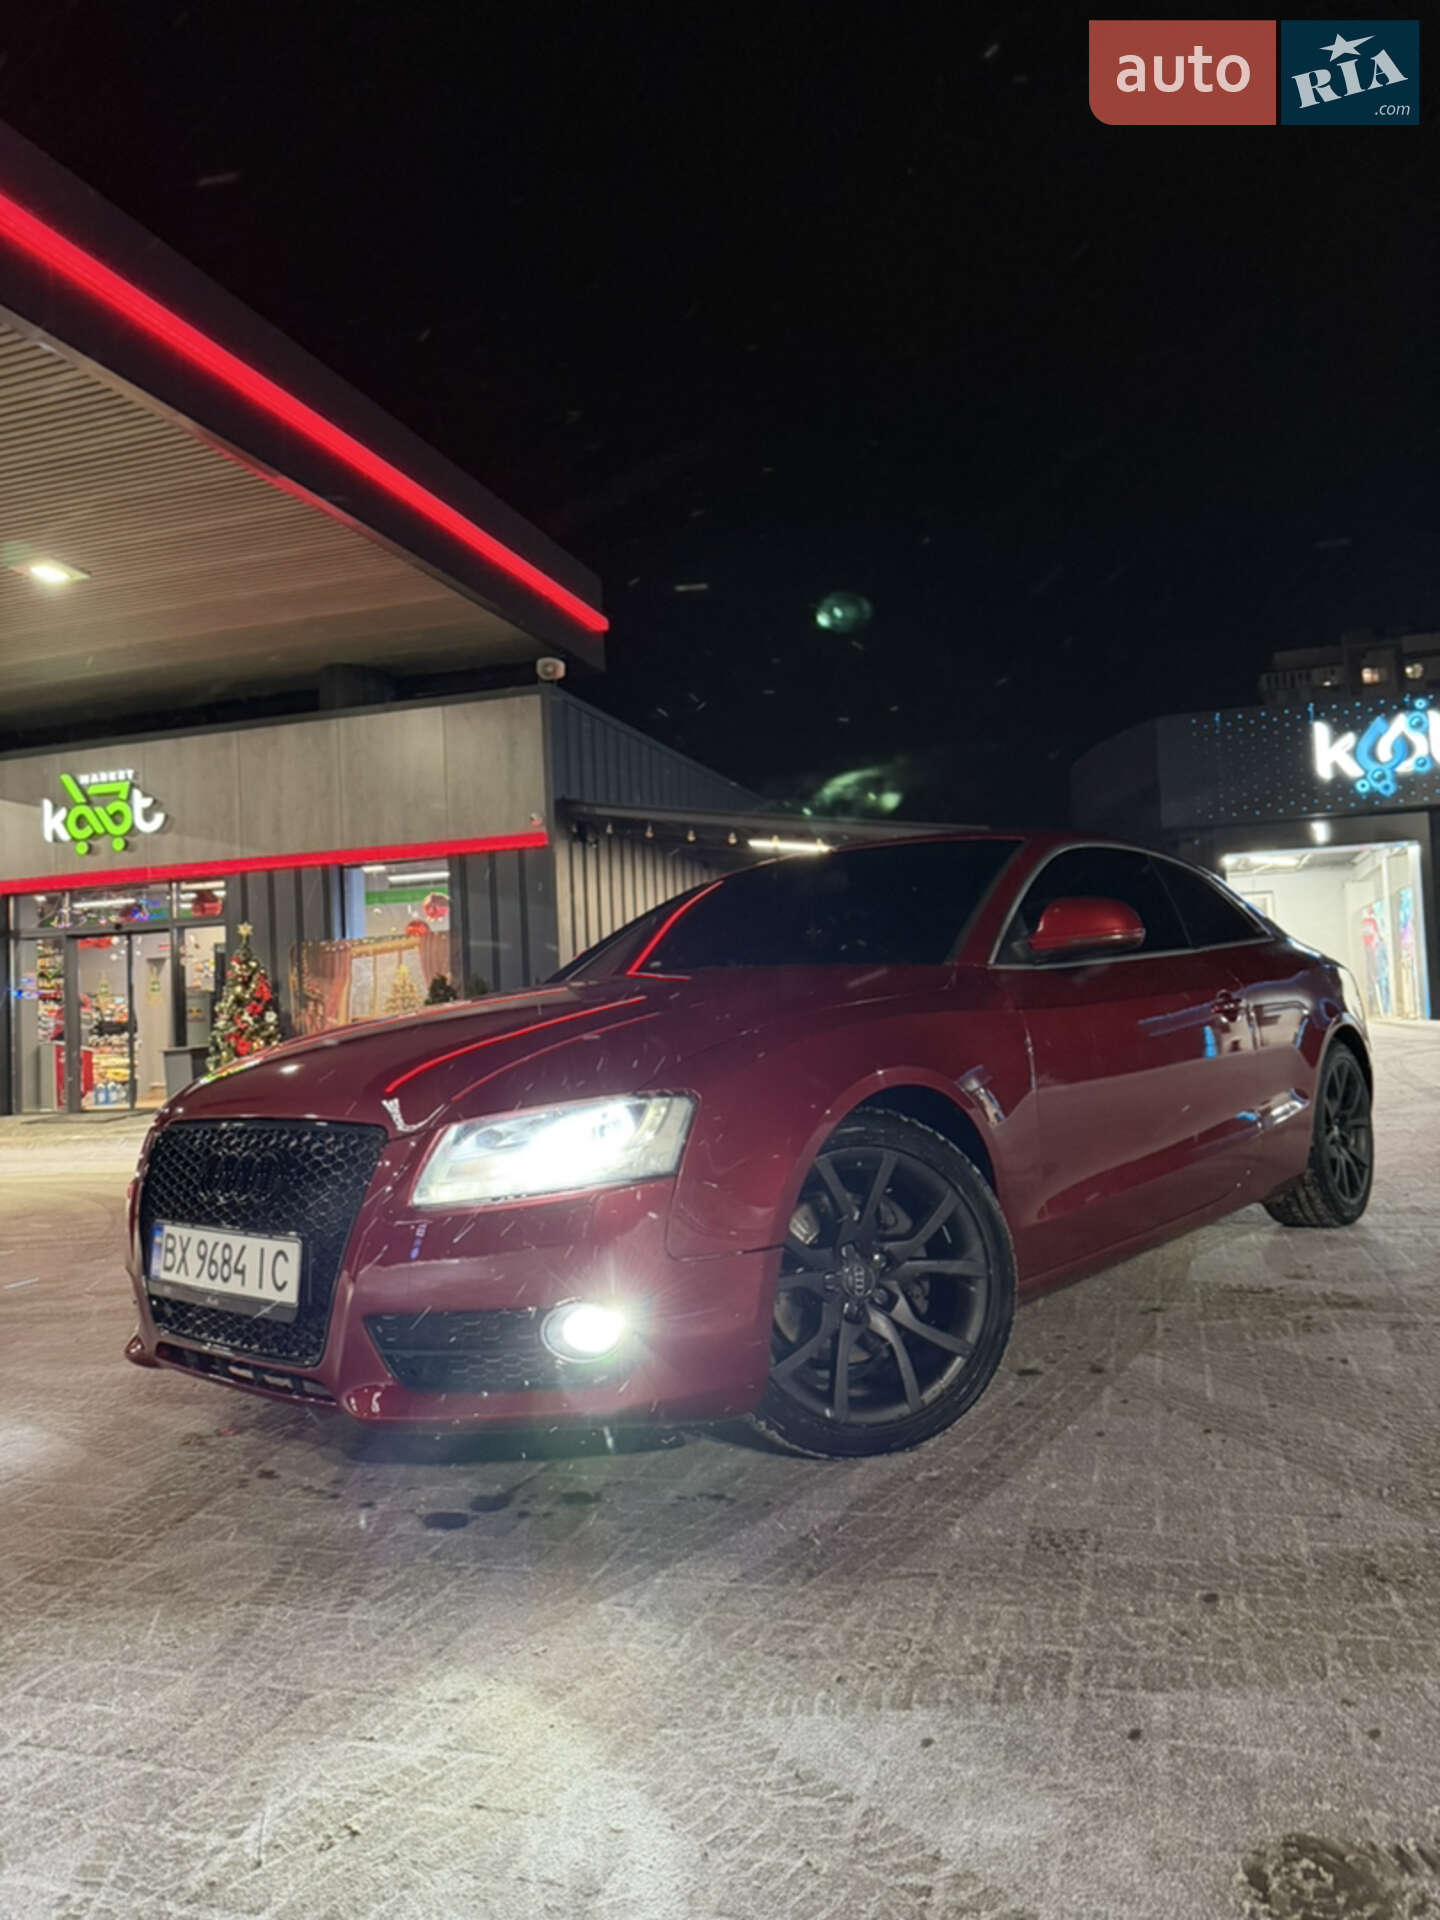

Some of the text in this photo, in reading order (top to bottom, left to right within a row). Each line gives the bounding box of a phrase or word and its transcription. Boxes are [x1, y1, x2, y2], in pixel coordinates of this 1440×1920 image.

[163, 1233, 289, 1292] BX 9684 IC
